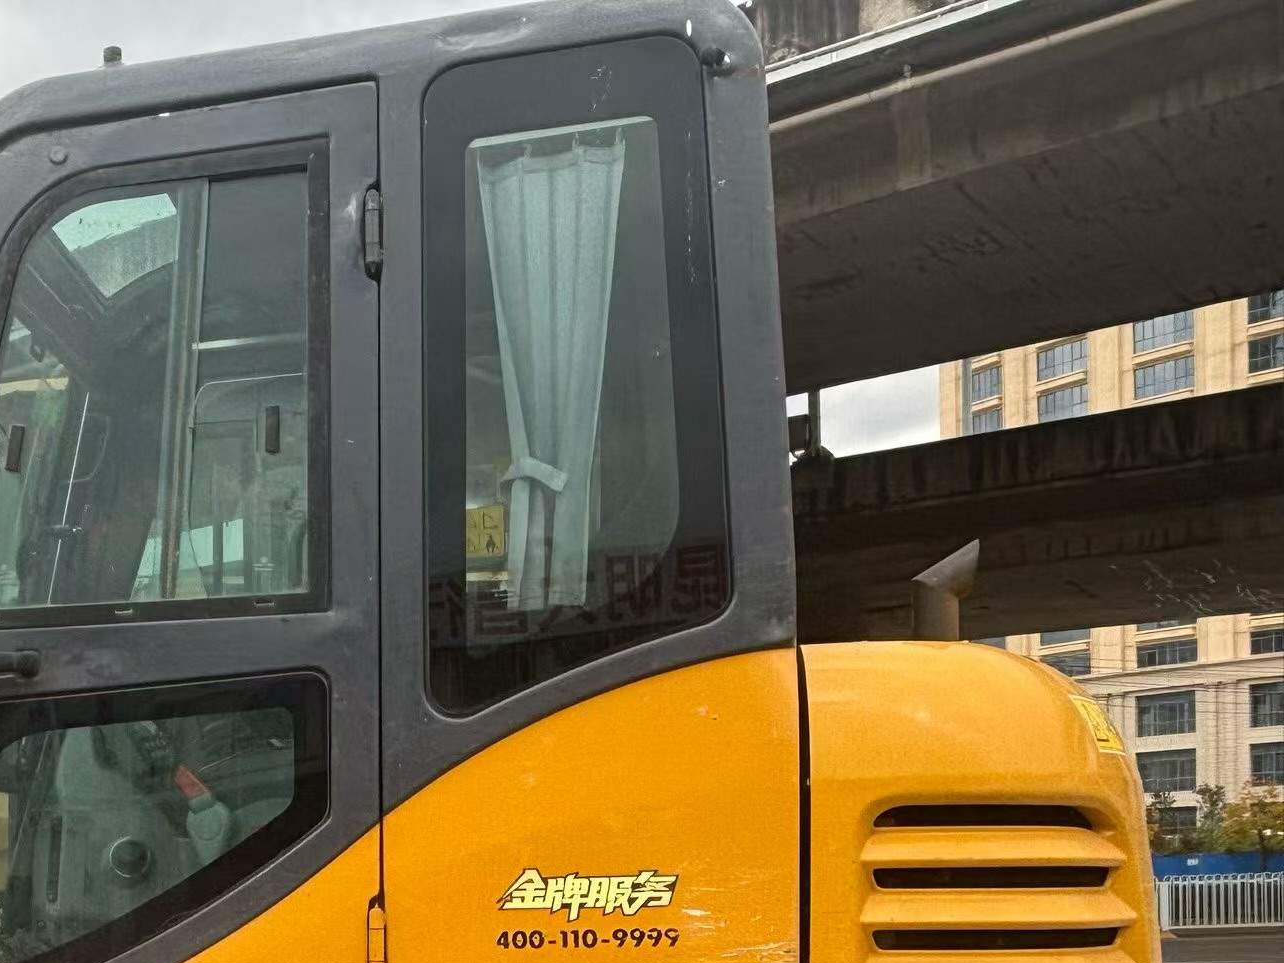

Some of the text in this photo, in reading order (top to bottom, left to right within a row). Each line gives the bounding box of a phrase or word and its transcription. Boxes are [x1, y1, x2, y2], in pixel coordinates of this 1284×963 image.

[497, 867, 679, 923] 金牌服务
[496, 927, 680, 949] 400-110-9999
